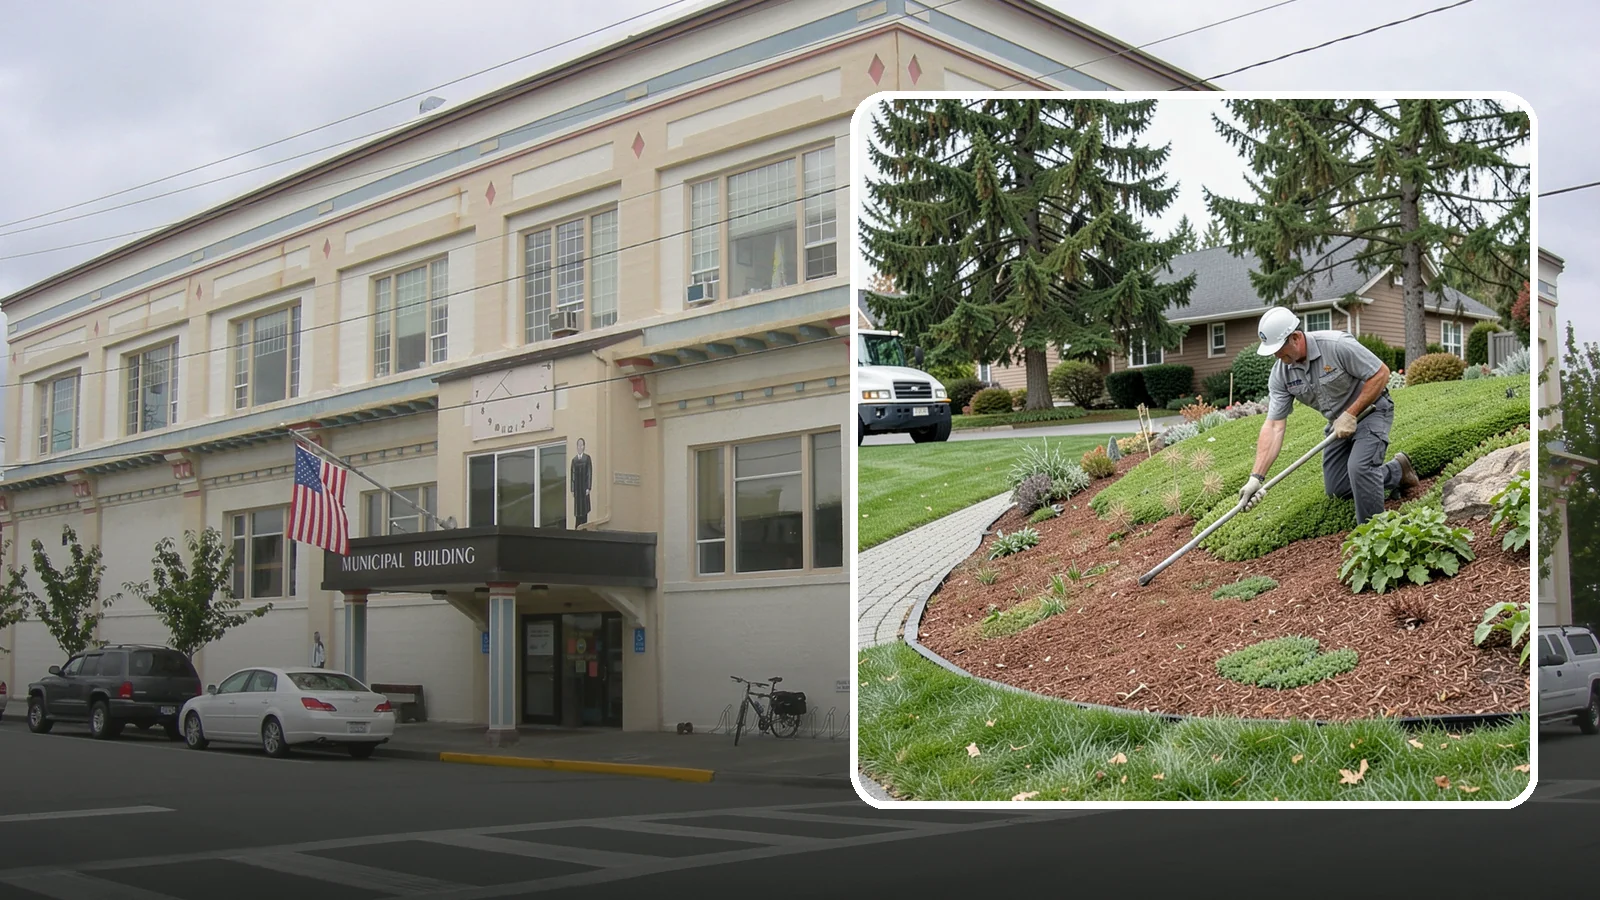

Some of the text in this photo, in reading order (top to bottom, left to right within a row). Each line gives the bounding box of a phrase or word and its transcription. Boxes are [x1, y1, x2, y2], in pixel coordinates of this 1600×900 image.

[488, 418, 492, 426] 9
[342, 546, 475, 572] MUNICIPAL BUILDING
